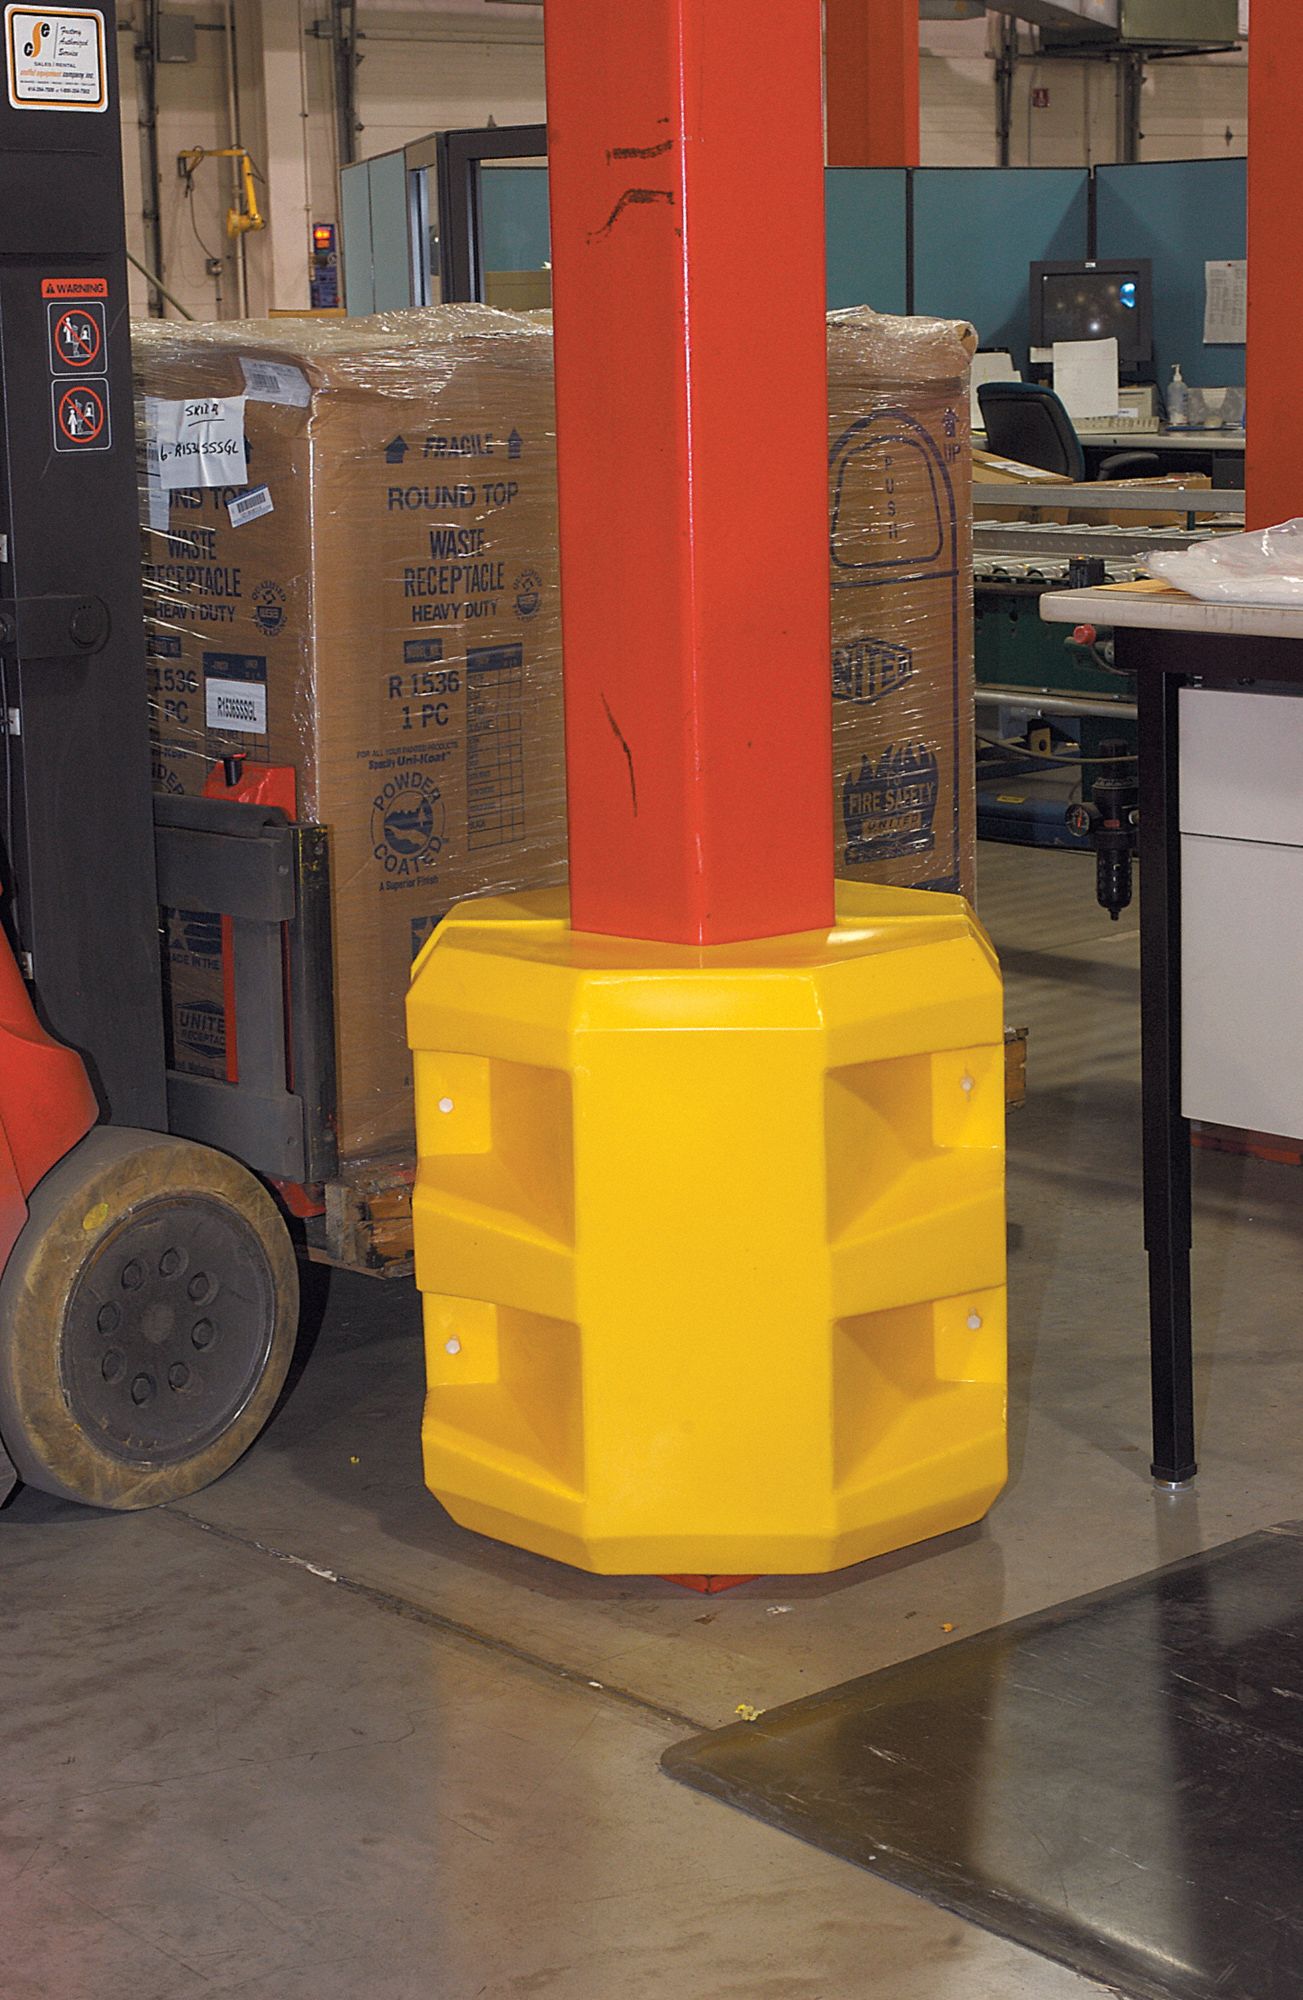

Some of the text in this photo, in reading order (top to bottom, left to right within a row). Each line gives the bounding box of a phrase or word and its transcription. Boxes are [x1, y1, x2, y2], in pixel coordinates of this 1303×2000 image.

[57, 283, 104, 294] WARNING
[423, 432, 495, 458] FRAGILE
[387, 481, 519, 511] ROUND TOP
[167, 529, 217, 560] WASTE
[429, 528, 485, 560] WASTE
[403, 562, 505, 597] RECEPTACLE
[154, 600, 198, 620] HEAVY
[200, 604, 236, 622] DUTY
[411, 601, 462, 623] HEAVY
[465, 598, 500, 619] DUTY
[389, 675, 403, 699] R
[412, 670, 460, 698] 1536
[164, 699, 189, 724] PC
[402, 706, 413, 730] 1
[421, 702, 449, 728] PC
[373, 771, 441, 812] POWDER
[849, 781, 935, 816] FIRE SAFETY
[374, 836, 442, 876] COATED
[180, 1010, 226, 1035] UNITE
